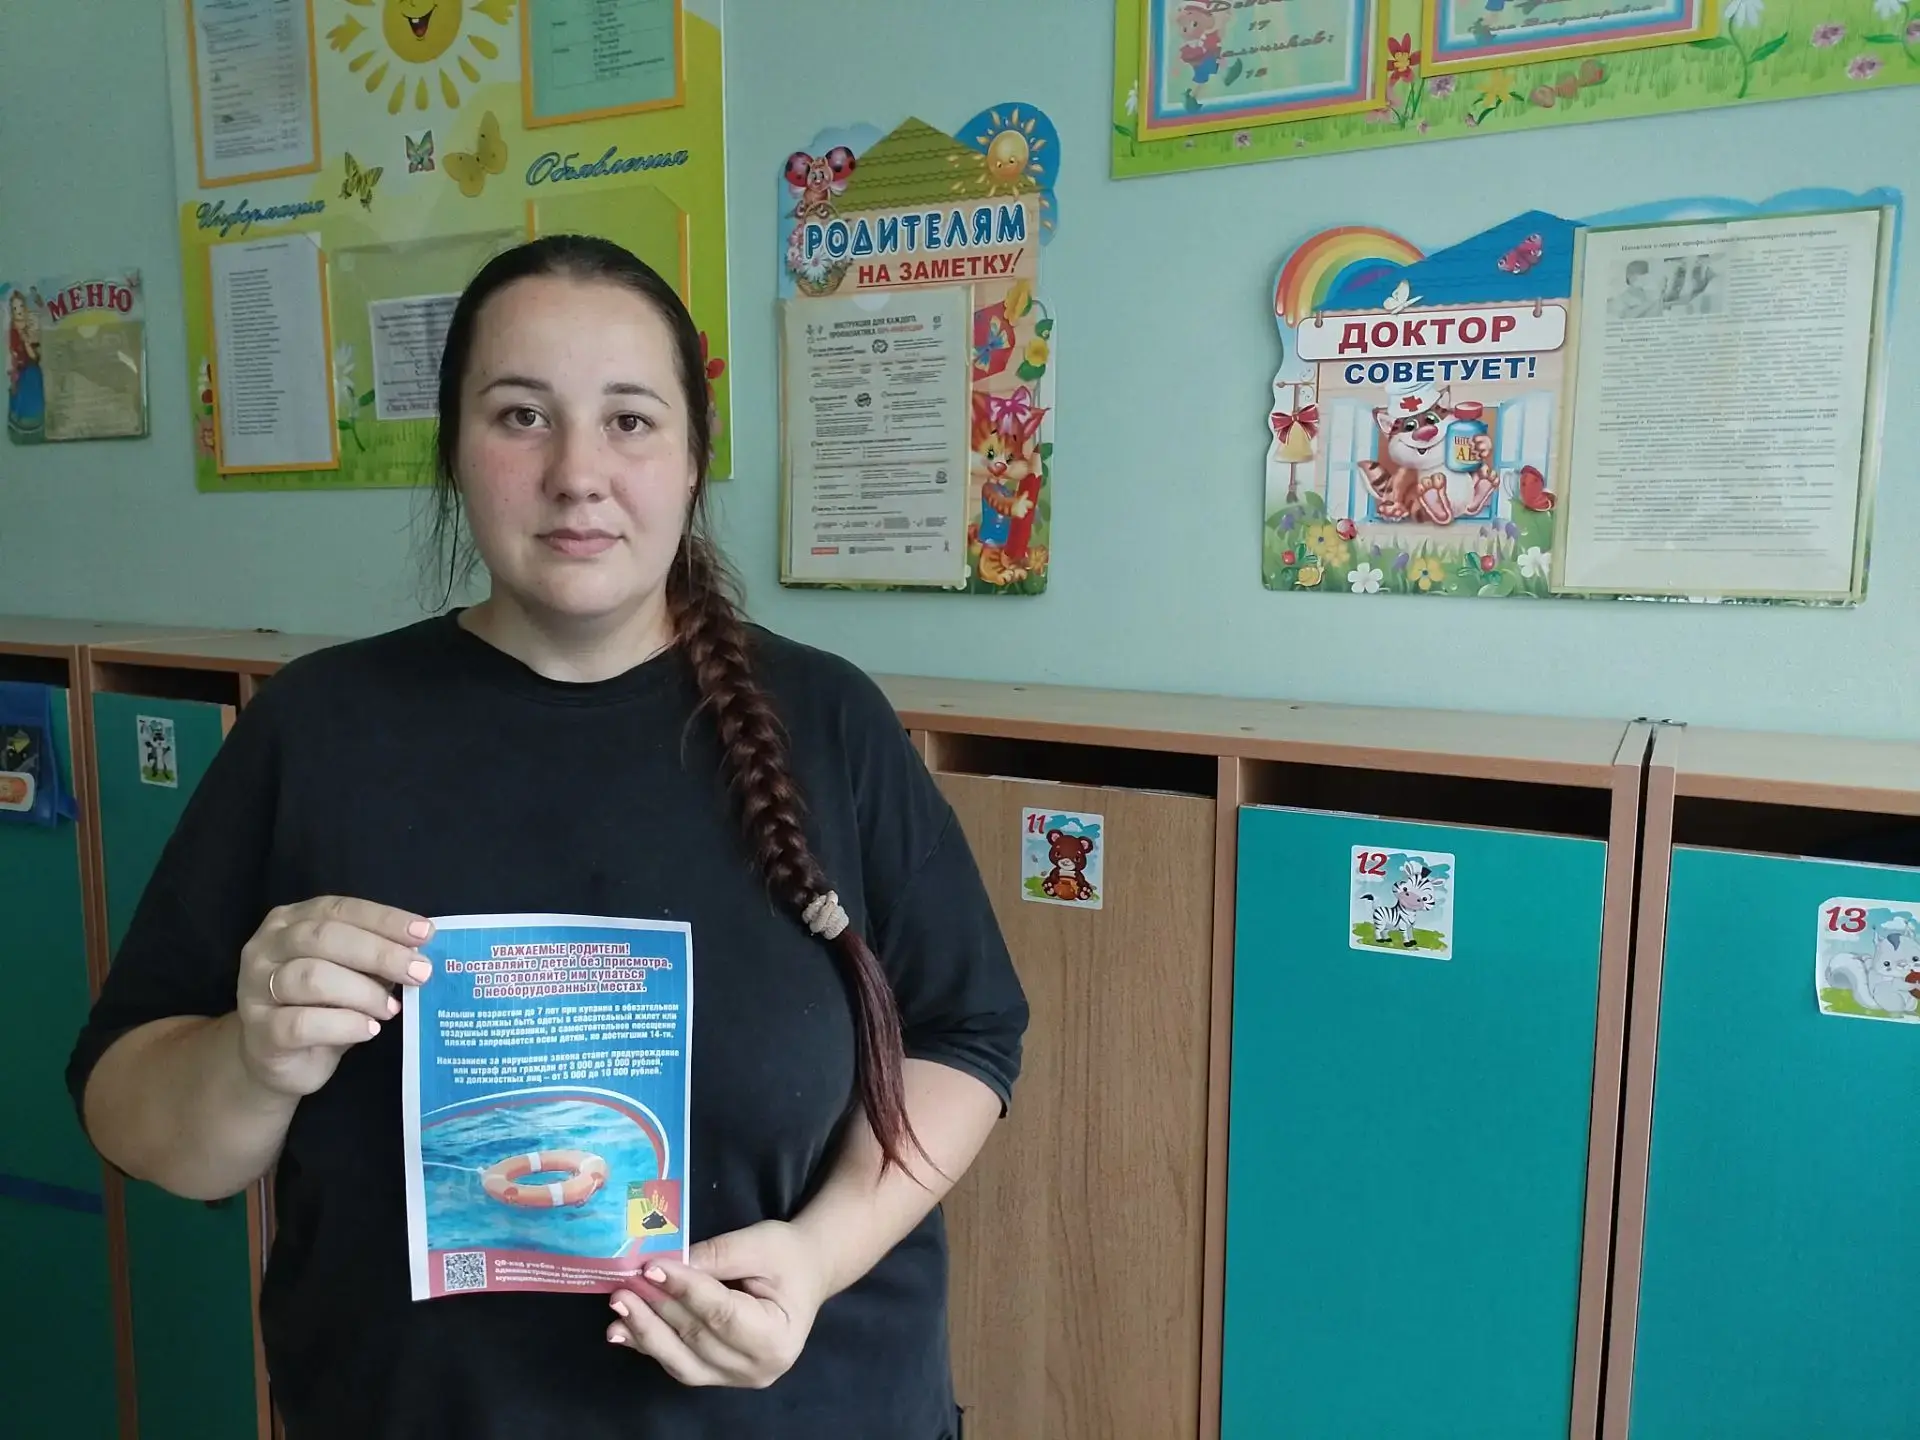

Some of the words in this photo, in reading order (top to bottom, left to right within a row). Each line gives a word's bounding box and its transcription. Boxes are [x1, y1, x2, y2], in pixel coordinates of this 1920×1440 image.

[525, 145, 690, 187] Объявления
[195, 198, 326, 238] Информация
[804, 202, 1027, 260] РОДИТЕЛЯМ
[858, 262, 892, 284] НА
[899, 248, 1024, 280] ЗАМЕТКУ!
[47, 283, 132, 322] МЕНЮ
[1338, 315, 1517, 354] ДОКТОР
[1344, 357, 1537, 385] СОВЕТУЕТ!
[1027, 813, 1046, 834] 11
[1357, 852, 1388, 876] 12
[1826, 906, 1867, 933] 13
[492, 944, 566, 957] УВАЖАЕМЫЕ
[569, 943, 630, 955] РОДИТЕЛИ!
[446, 961, 462, 972] Не
[466, 958, 537, 972] оставляйте
[541, 956, 576, 969] детей
[580, 956, 599, 967] без
[476, 975, 491, 984] не
[571, 970, 587, 979] им
[591, 969, 645, 981] купаться
[474, 988, 481, 997] в
[485, 983, 597, 998] необорудованных
[600, 982, 646, 993] местах.
[438, 1009, 475, 1019] Малыши
[477, 1008, 523, 1019] возрастом
[524, 1008, 535, 1017] до
[622, 1003, 679, 1012] обязательном
[440, 1020, 474, 1029] порядке
[476, 1019, 512, 1028] должны
[514, 1017, 535, 1026] быть
[611, 1049, 680, 1059] предупреждение
[470, 1065, 499, 1076] штраф
